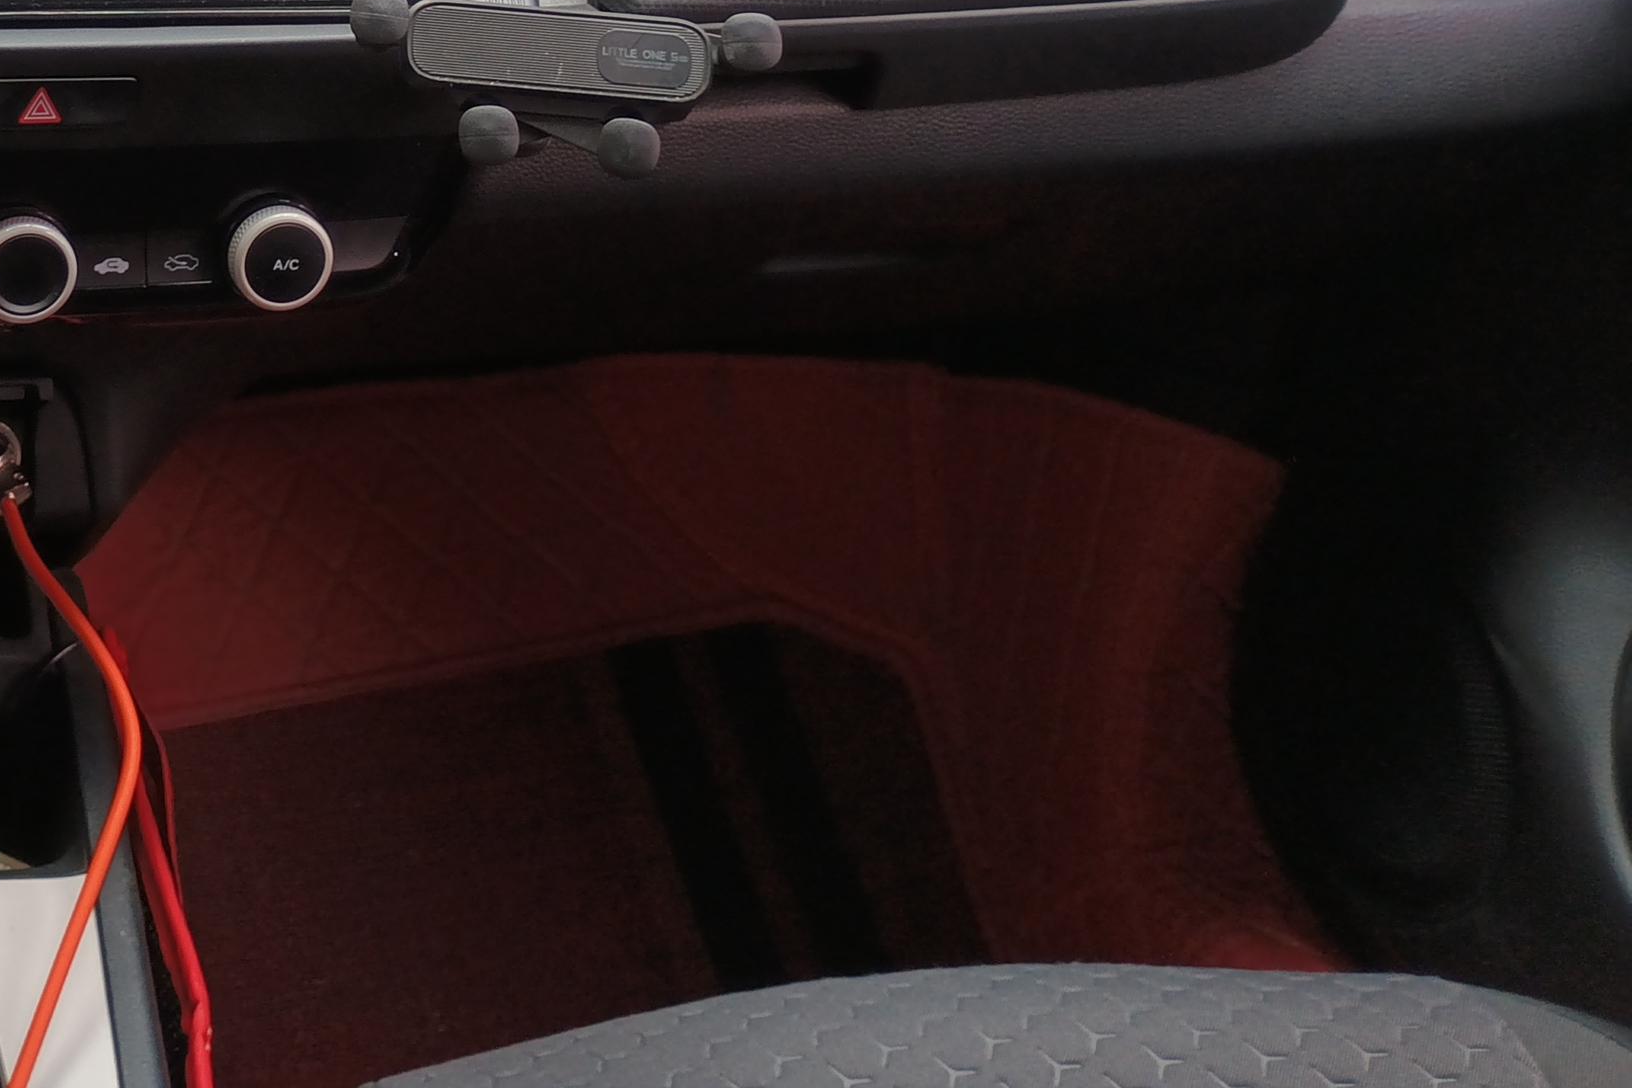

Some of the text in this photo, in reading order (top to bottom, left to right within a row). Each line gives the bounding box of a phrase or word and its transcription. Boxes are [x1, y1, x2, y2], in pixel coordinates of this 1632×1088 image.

[601, 46, 637, 59] LITTLE
[642, 49, 666, 61] ONE
[272, 258, 300, 272] A/C
